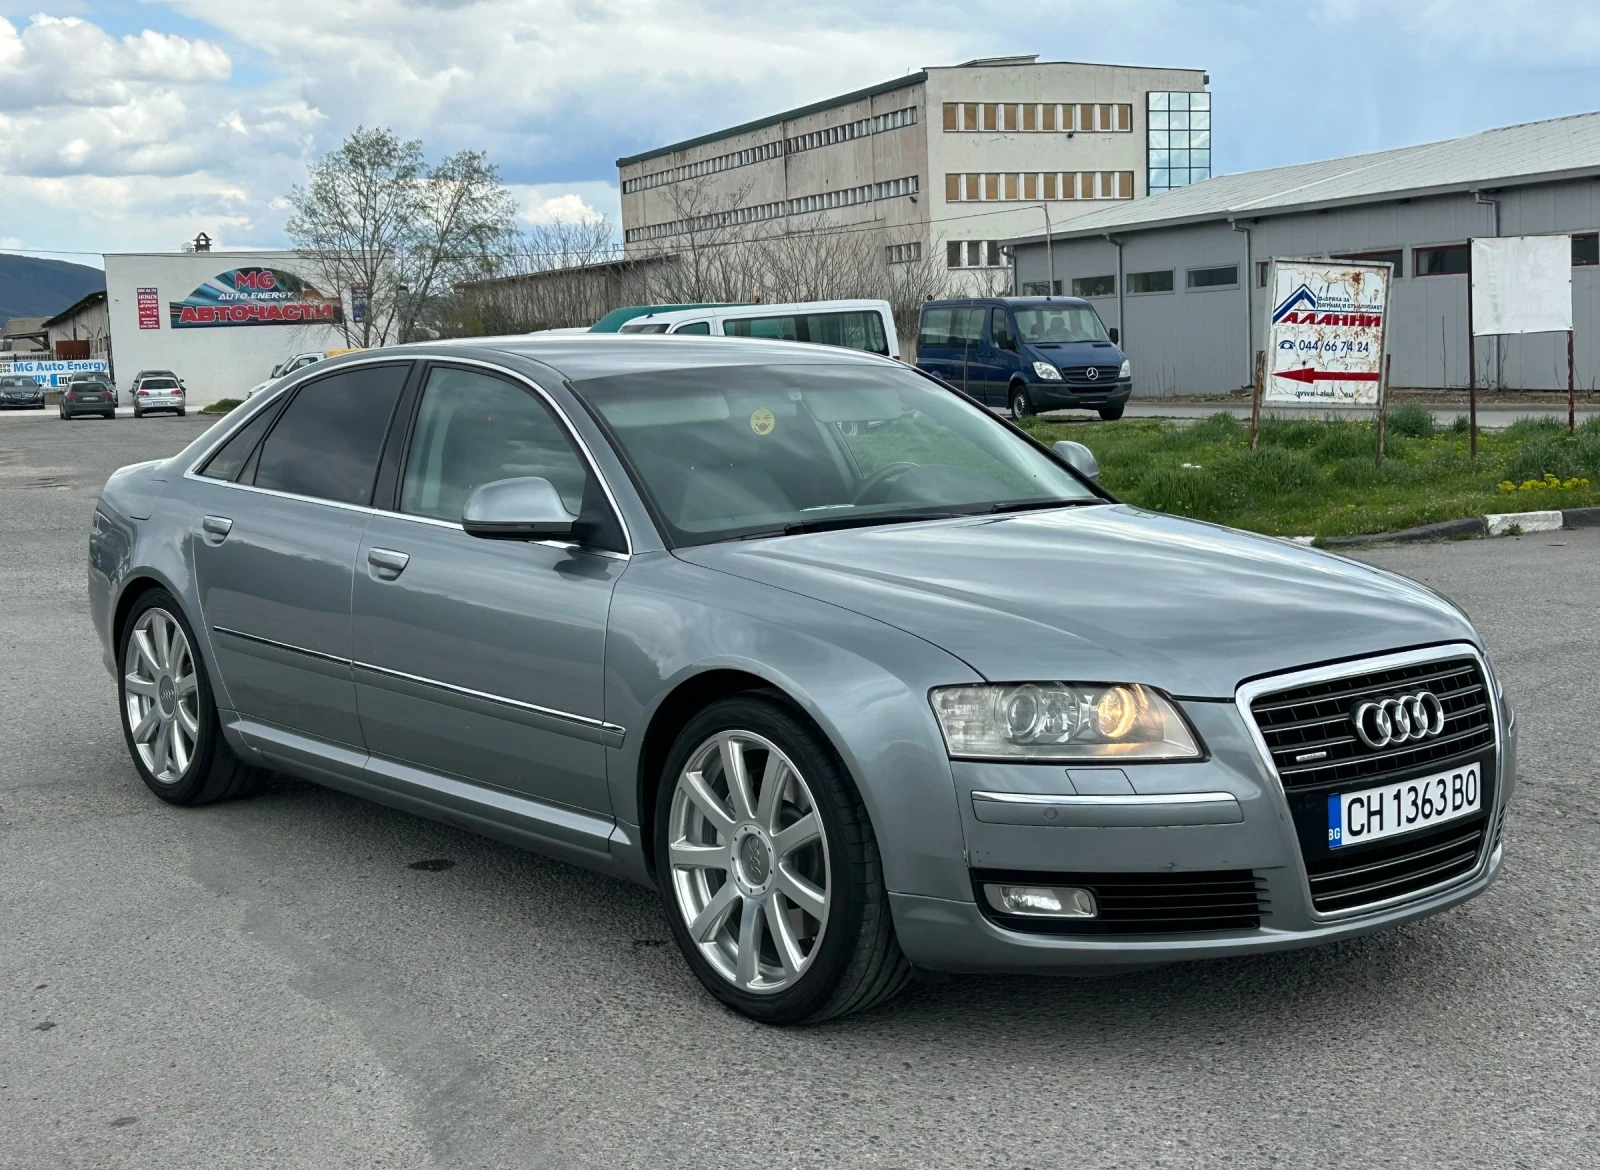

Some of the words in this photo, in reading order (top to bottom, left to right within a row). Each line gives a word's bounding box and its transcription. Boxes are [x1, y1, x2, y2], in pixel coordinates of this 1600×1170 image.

[234, 271, 276, 290] MG
[179, 303, 333, 323] АВТОЧАСТИ
[1281, 312, 1381, 327] АЛАННИ
[1357, 342, 1369, 352] 24
[14, 362, 33, 372] MG
[36, 362, 64, 371] Auto
[67, 361, 108, 372] Energy
[1347, 793, 1384, 836] CH
[1393, 779, 1448, 828] 1363
[1452, 769, 1477, 812] BO
[1329, 828, 1341, 840] BG
